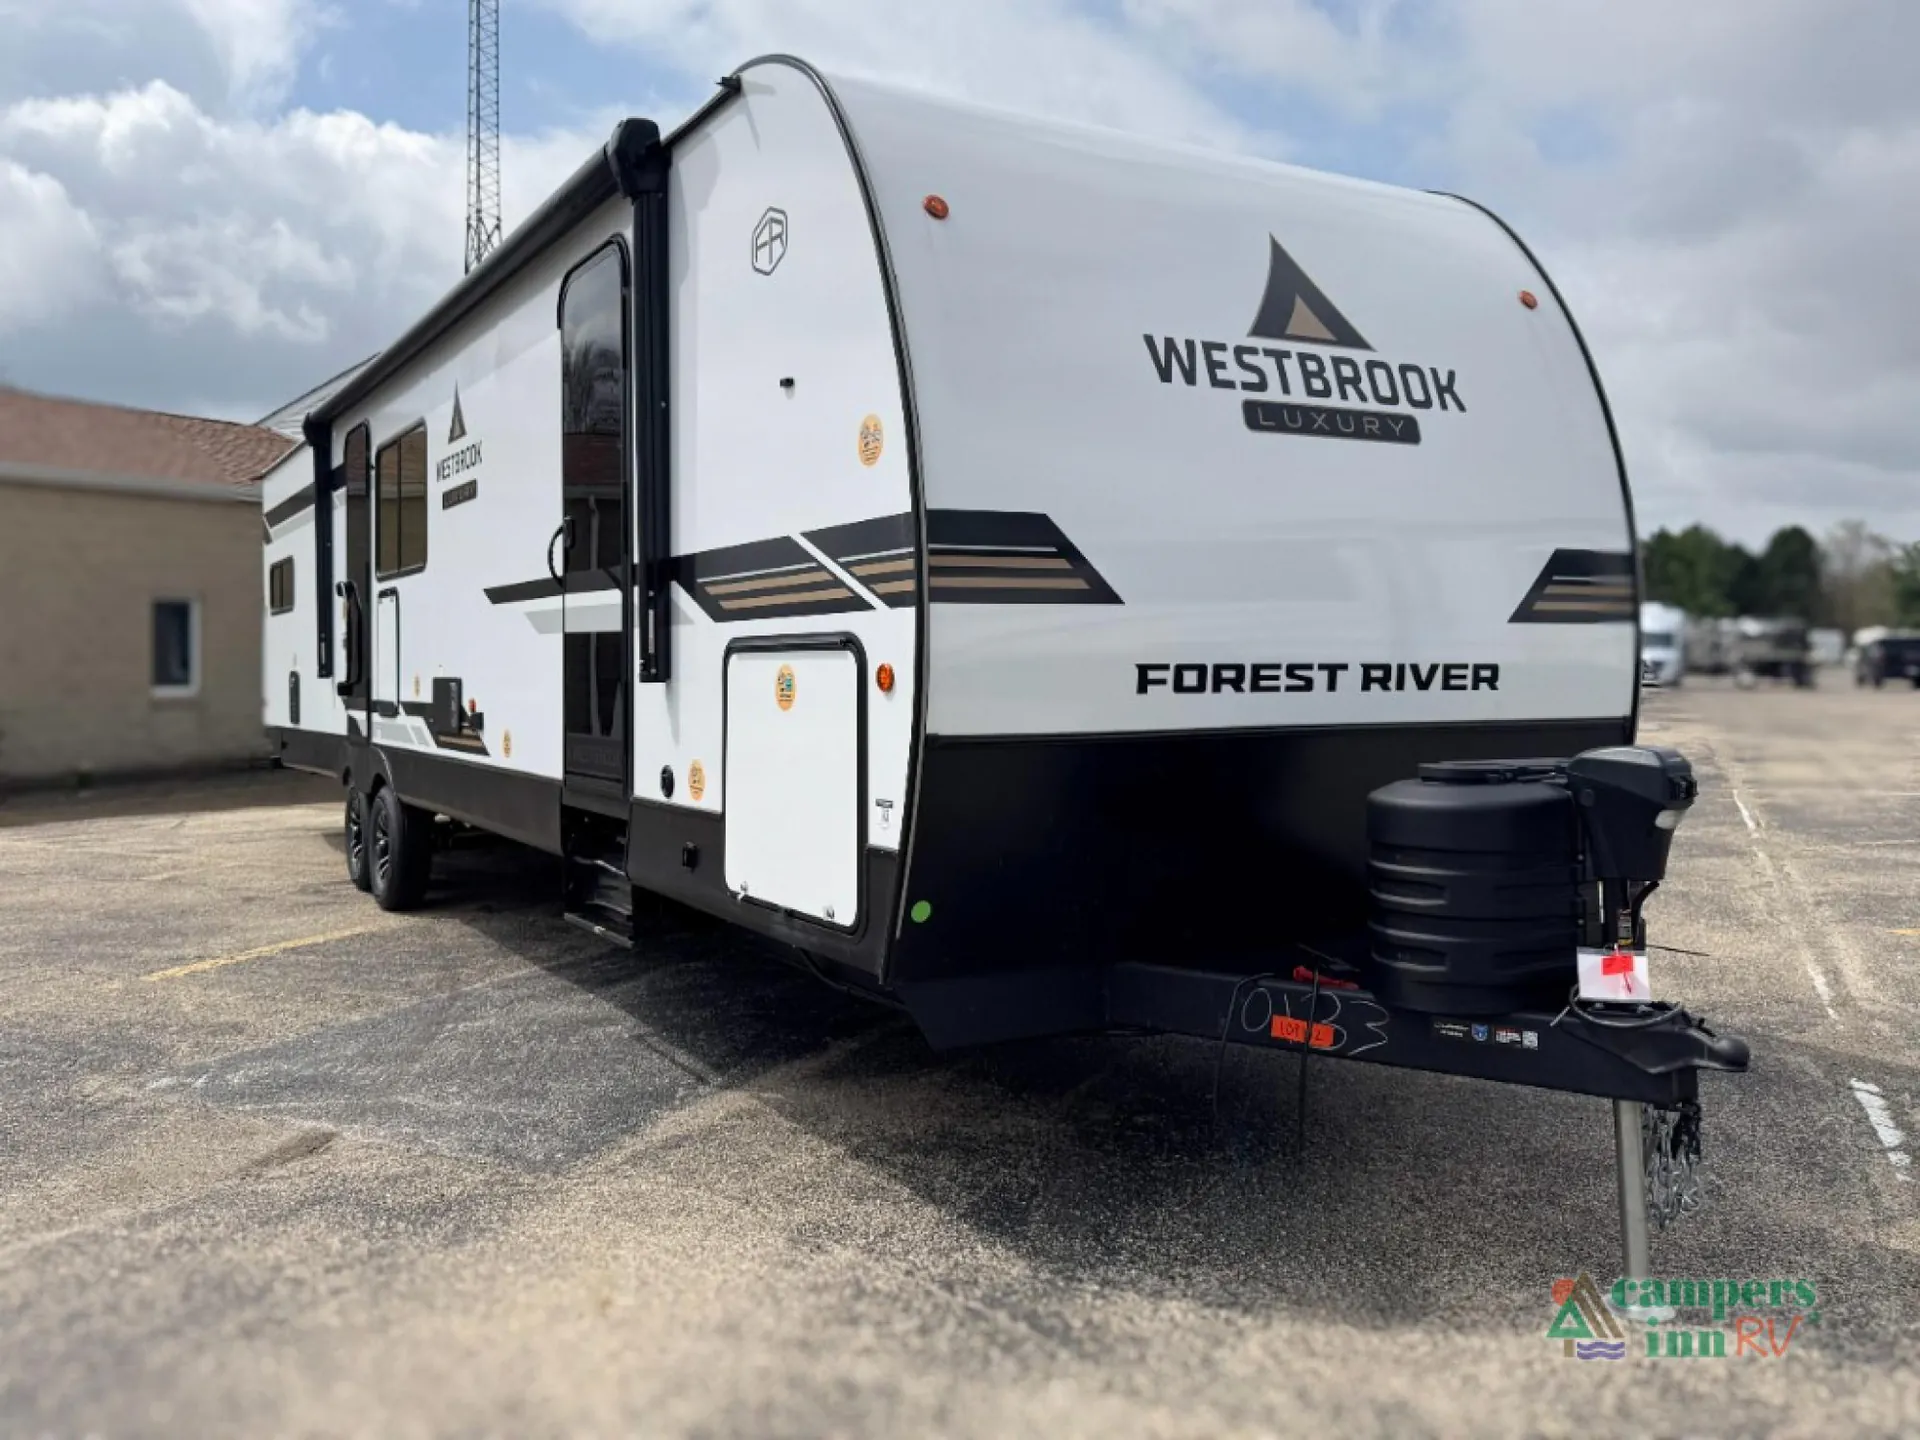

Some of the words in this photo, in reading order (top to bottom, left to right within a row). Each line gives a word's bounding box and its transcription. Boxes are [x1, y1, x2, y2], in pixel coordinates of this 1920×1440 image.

[1143, 333, 1467, 412] WESTBROOK
[1256, 406, 1405, 437] LUXURY
[1135, 663, 1349, 694] FOREST
[1360, 663, 1500, 692] RIVER
